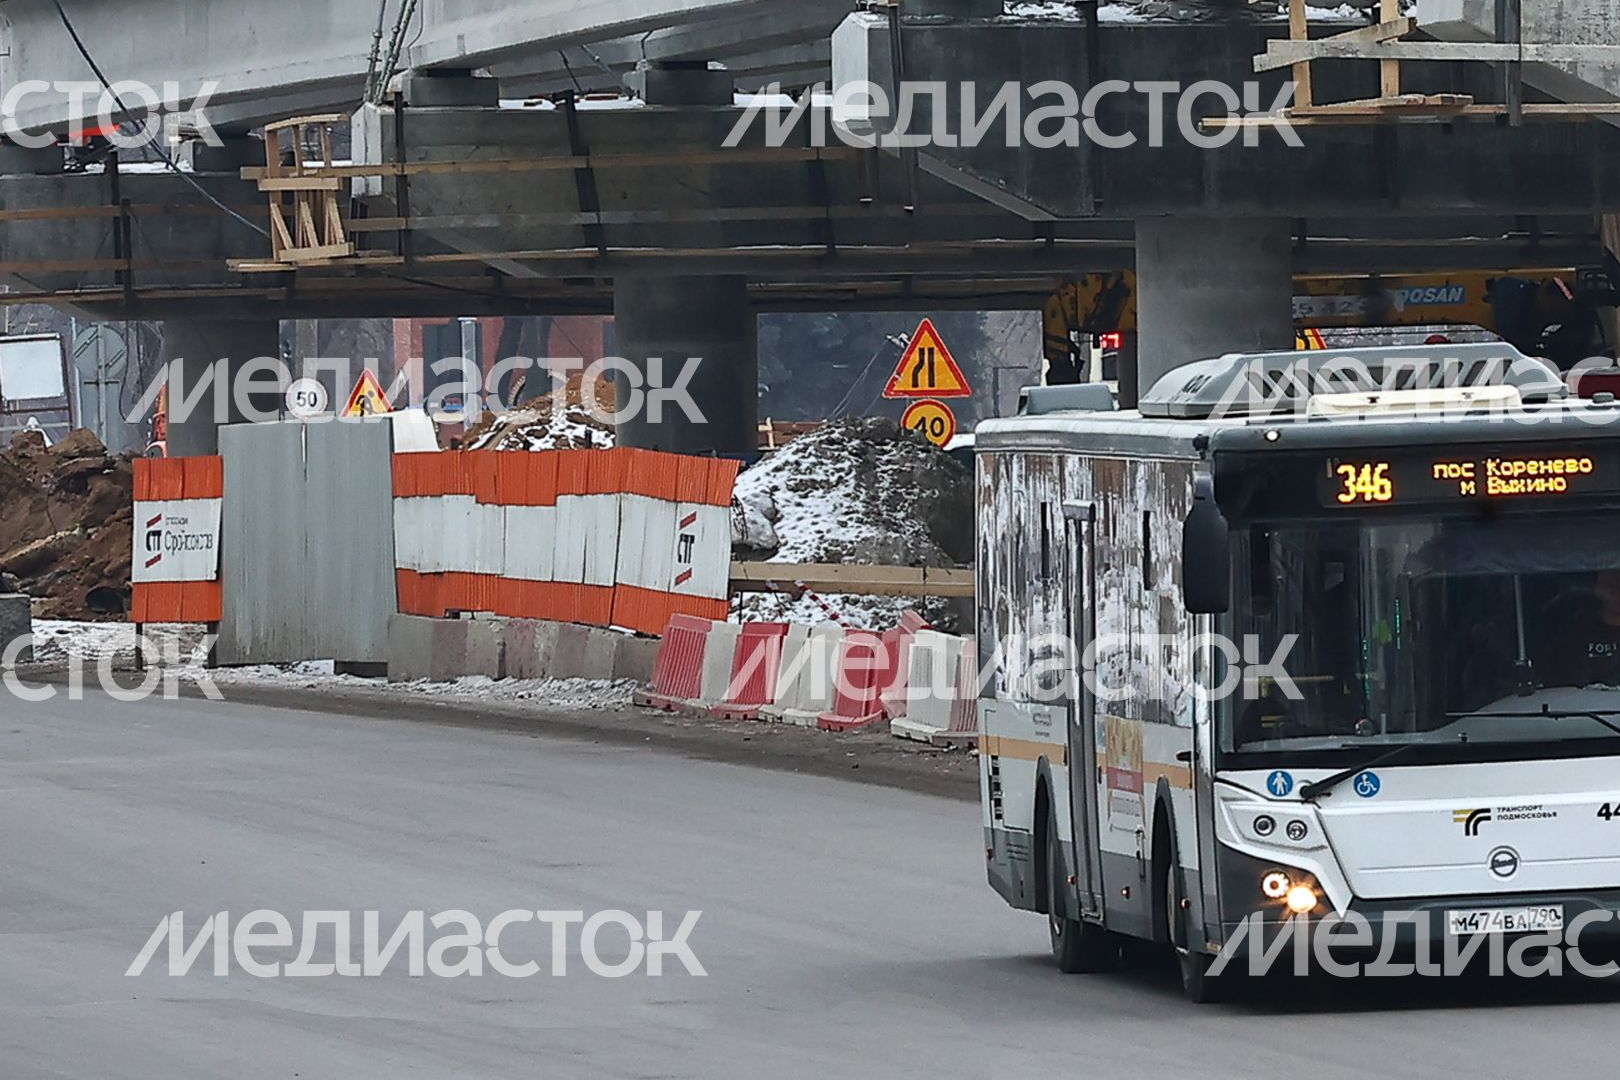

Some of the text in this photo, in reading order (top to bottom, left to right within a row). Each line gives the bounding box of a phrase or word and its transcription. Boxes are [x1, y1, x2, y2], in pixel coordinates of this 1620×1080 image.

[296, 391, 318, 408] 50
[914, 416, 945, 438] 40
[1433, 458, 1593, 479] пос Коренево
[1337, 463, 1393, 502] 346
[1460, 476, 1568, 496] м Выхино
[1497, 804, 1543, 813] ТРАНСПОРТ
[1497, 811, 1558, 821] ПОДМОСКОВЬЯ
